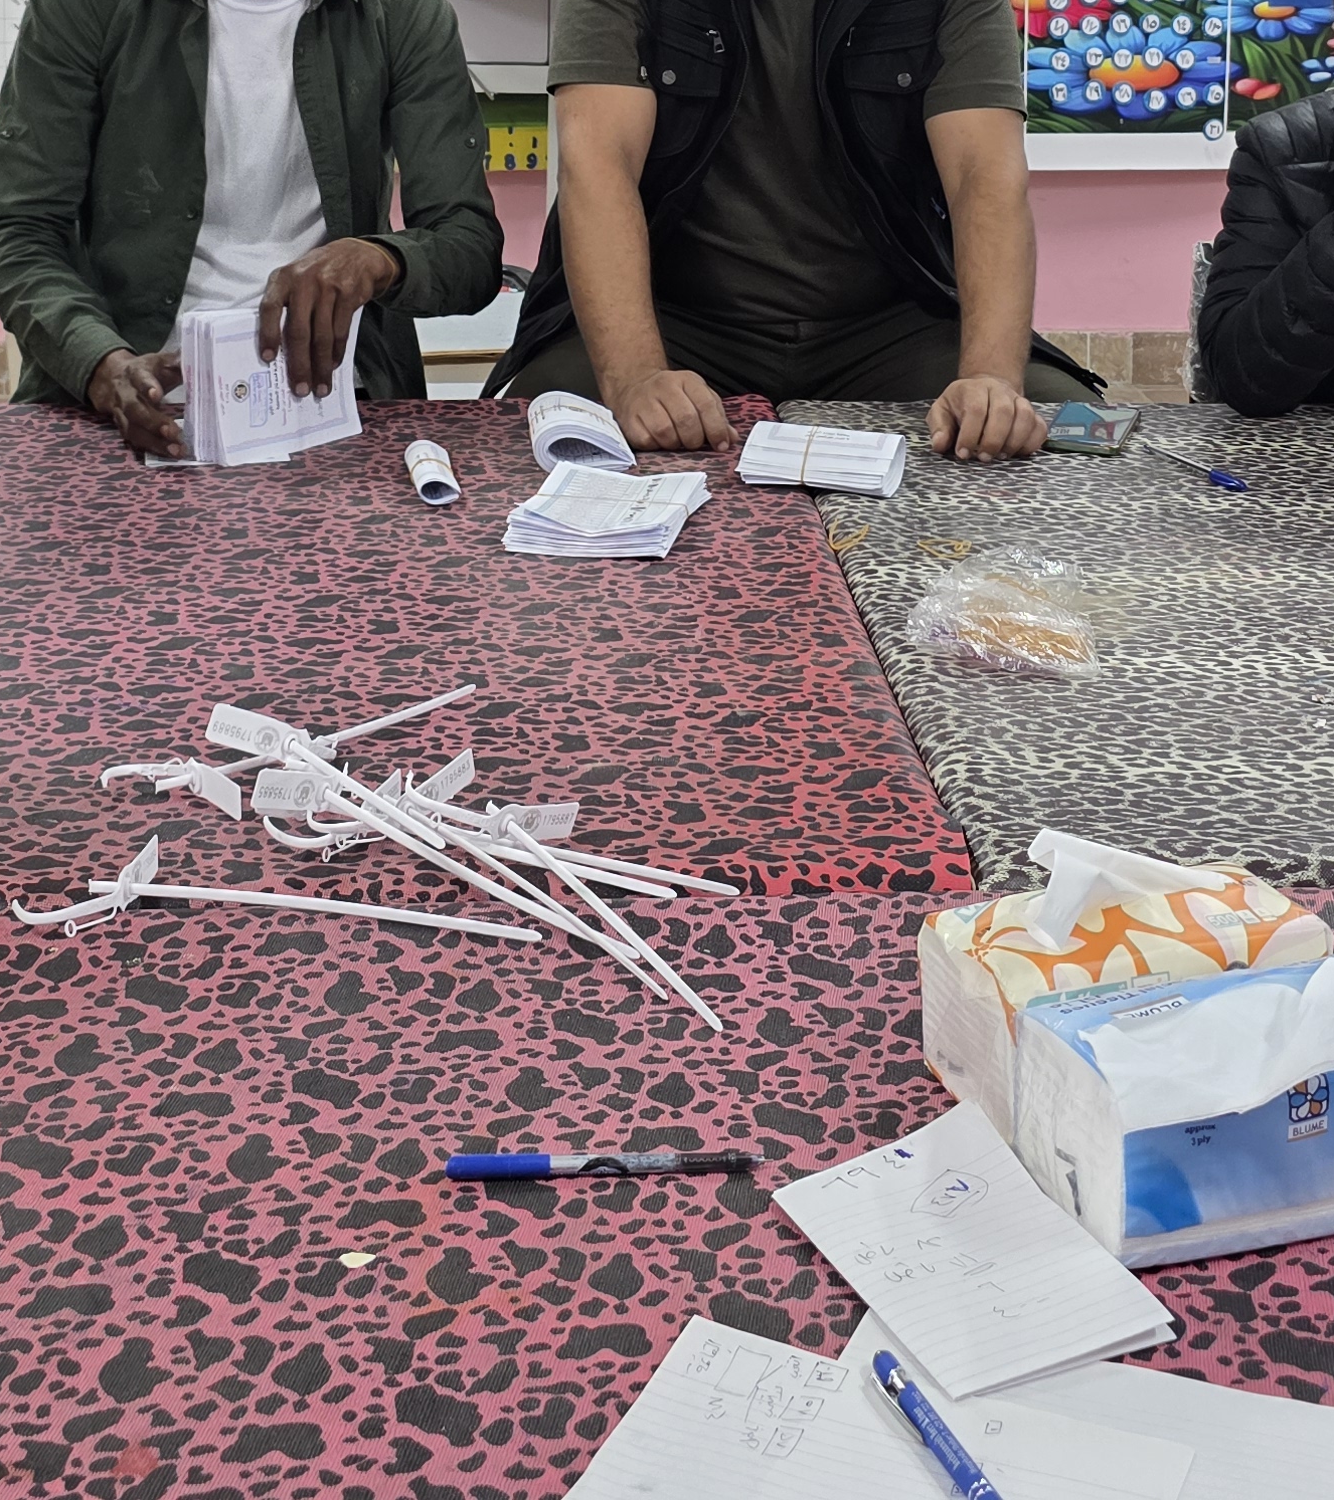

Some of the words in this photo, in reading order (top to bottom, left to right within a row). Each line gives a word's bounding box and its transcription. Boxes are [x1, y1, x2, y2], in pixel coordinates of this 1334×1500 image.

[212, 719, 253, 743] 1795889
[1292, 1120, 1325, 1137] BLUME
[1197, 1134, 1212, 1146] ply
